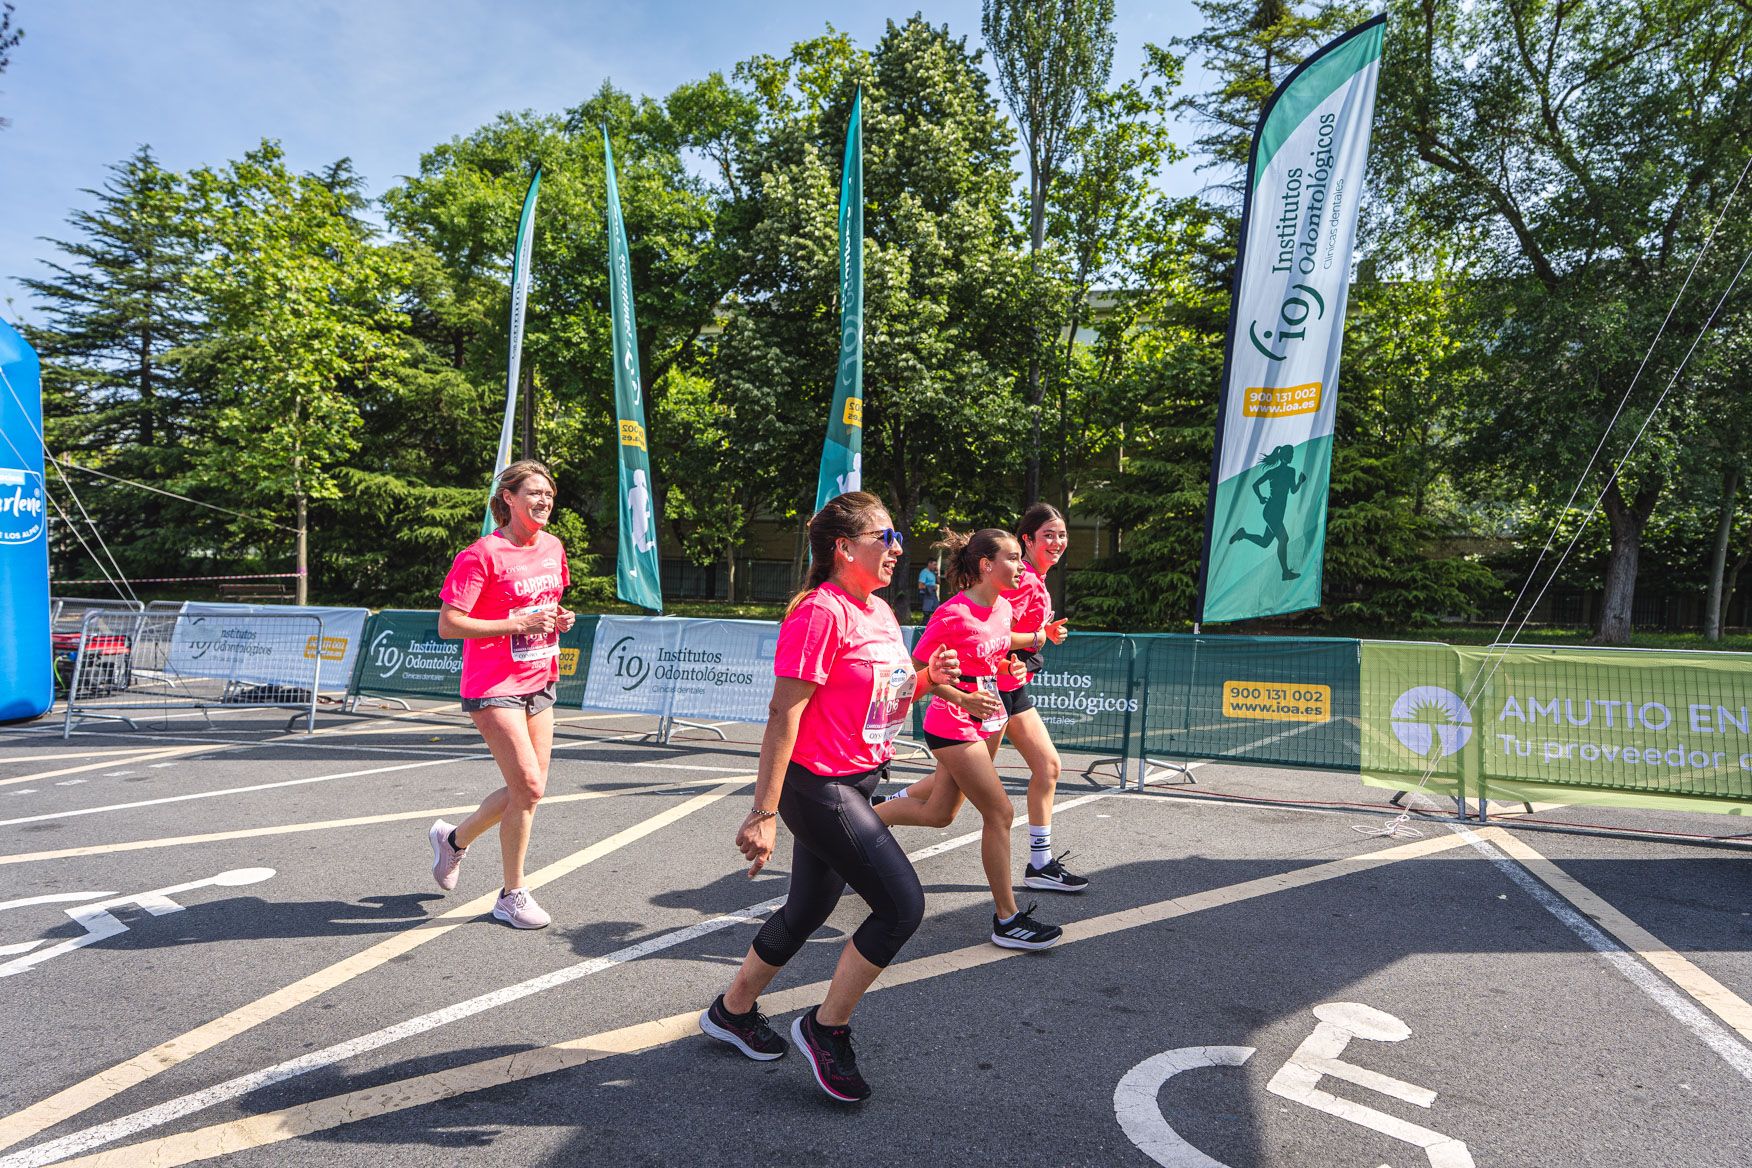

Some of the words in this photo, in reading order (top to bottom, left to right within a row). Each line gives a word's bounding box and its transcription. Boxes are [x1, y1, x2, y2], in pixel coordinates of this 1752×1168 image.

[1299, 113, 1336, 275] Odontológicos
[1330, 178, 1344, 227] dentales
[1272, 167, 1303, 274] Institutos
[1249, 391, 1272, 402] 900
[1275, 391, 1292, 402] 131
[1295, 387, 1316, 399] 002
[1249, 400, 1315, 413] www.ioa.es
[4, 532, 20, 540] LOS
[221, 627, 256, 640] nstitutos
[408, 640, 459, 654] Institutos
[657, 647, 722, 664] Institutos
[654, 664, 753, 686] Odontológicos
[1230, 687, 1261, 699] 900
[1265, 689, 1287, 700] 131
[1292, 690, 1323, 702] 002
[1028, 691, 1138, 715] ontológicos
[1230, 702, 1323, 715] www.ioa.es
[1041, 715, 1076, 725] entales
[1499, 695, 1672, 731] AMUTIO
[1497, 733, 1532, 757] Tu
[1544, 741, 1725, 769] proveedor
